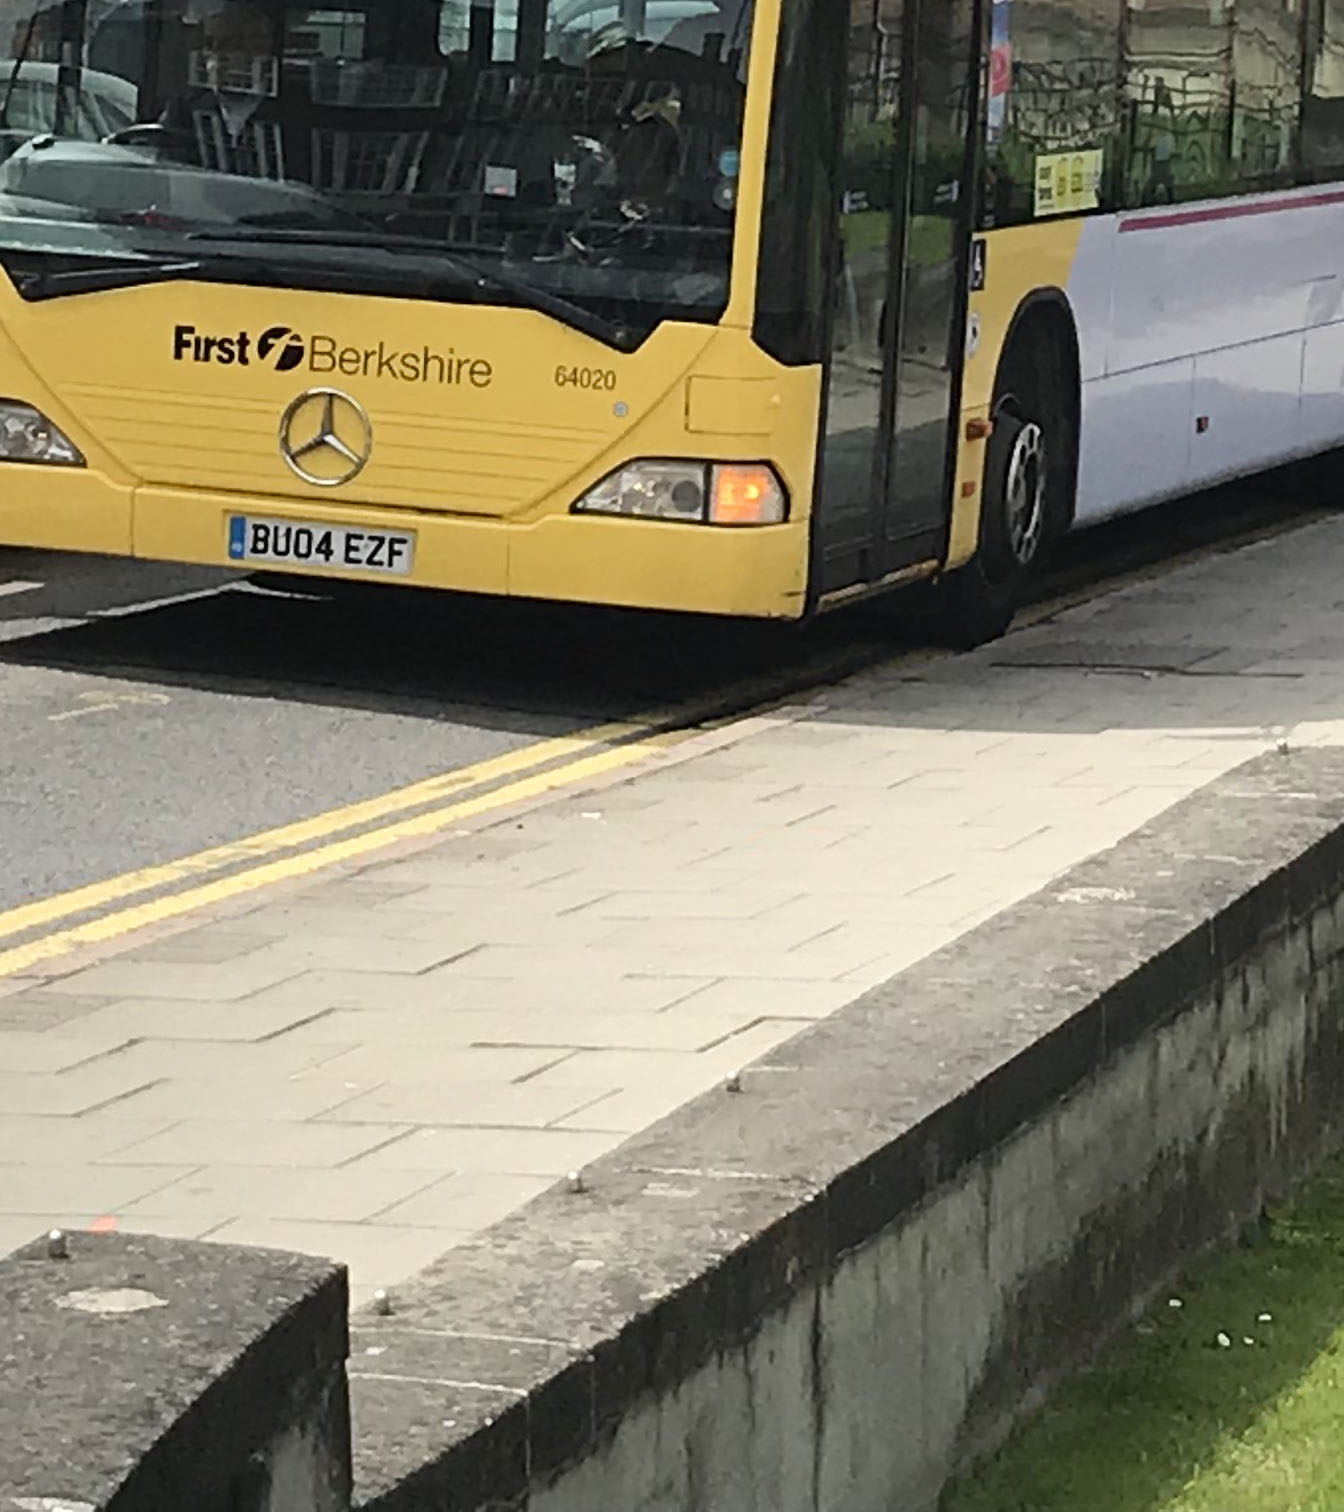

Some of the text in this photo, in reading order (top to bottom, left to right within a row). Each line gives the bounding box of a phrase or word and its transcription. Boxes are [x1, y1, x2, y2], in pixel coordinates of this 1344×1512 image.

[173, 325, 492, 388] First Berkshire
[554, 365, 616, 390] 64020
[249, 523, 408, 568] BU04 EZF
